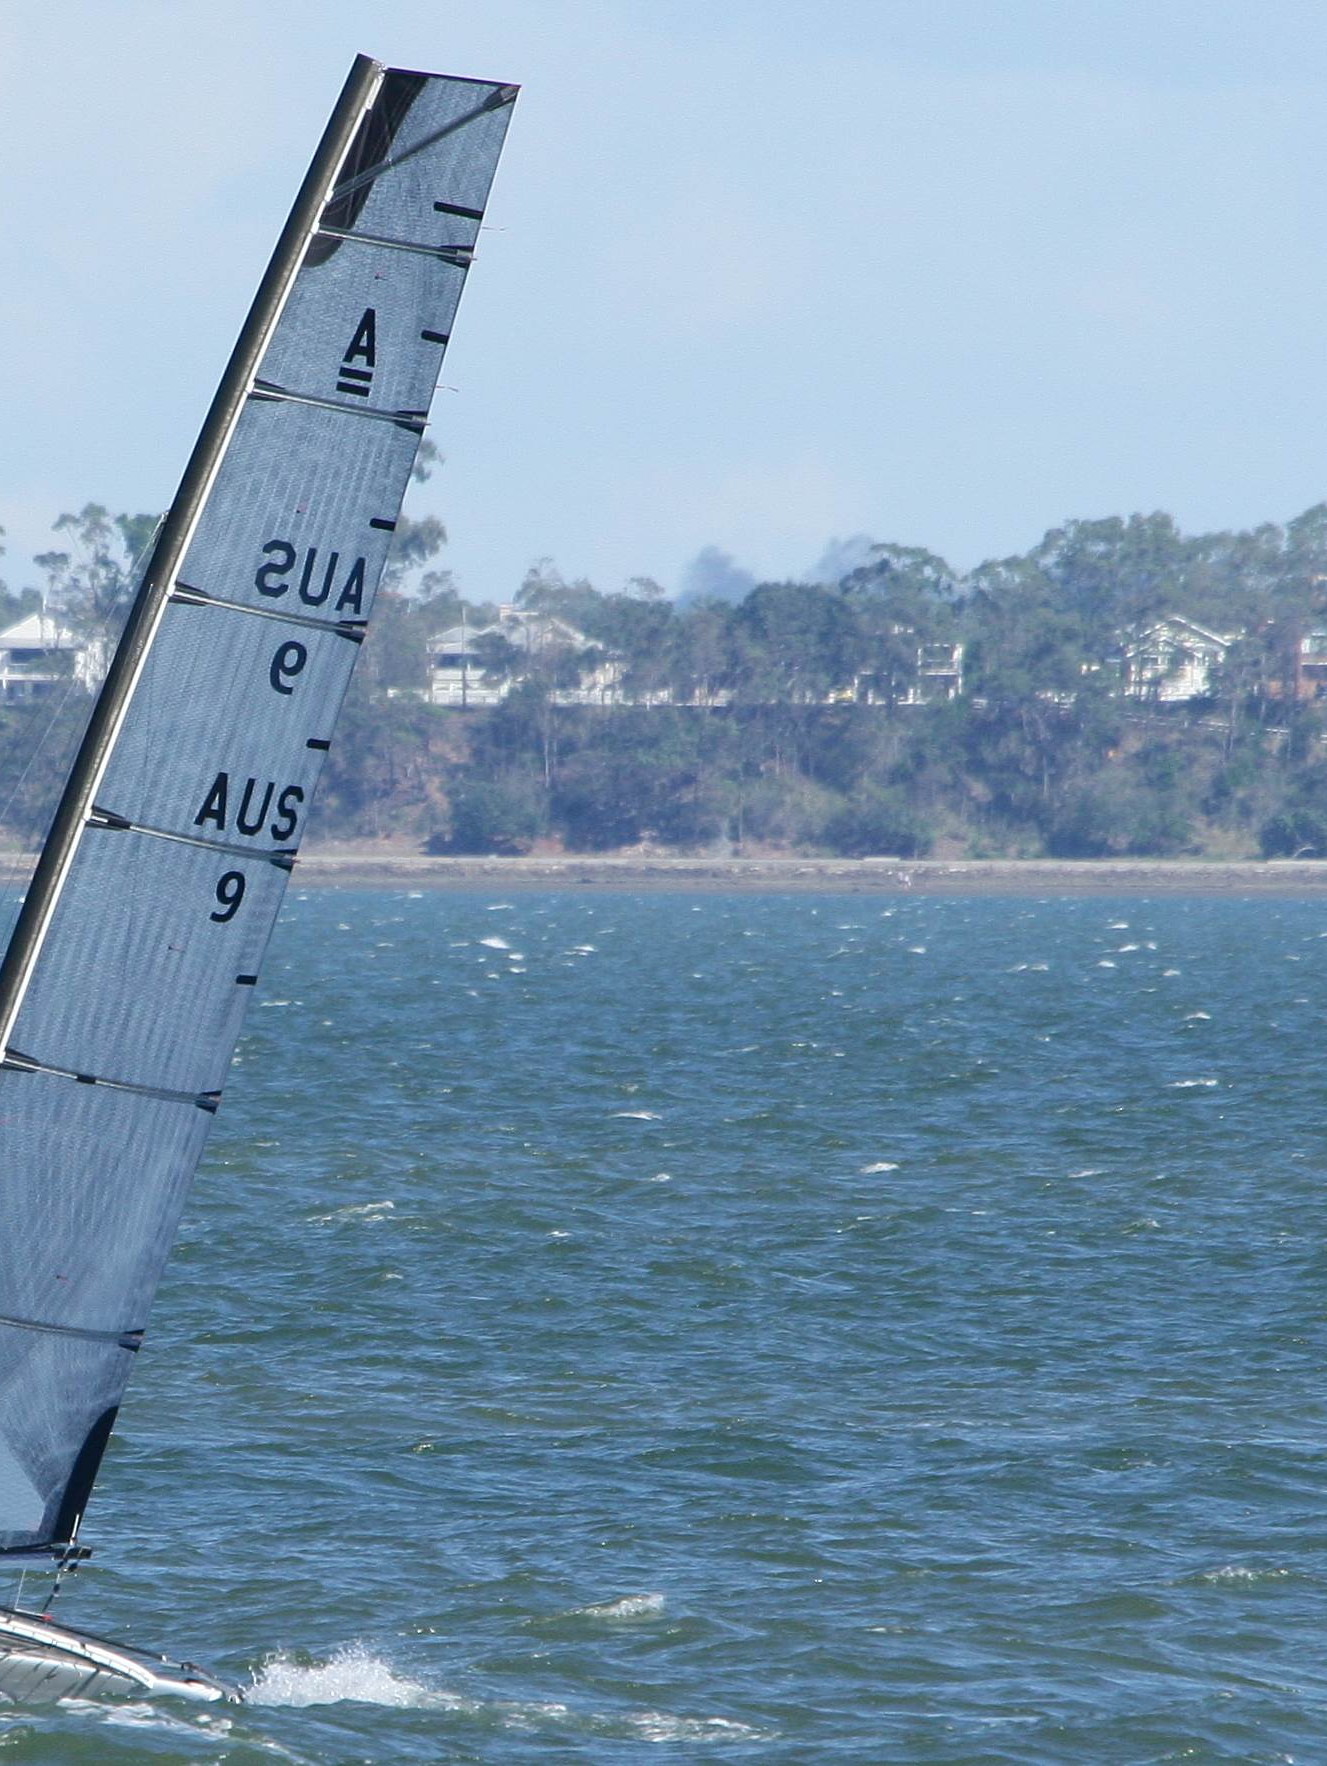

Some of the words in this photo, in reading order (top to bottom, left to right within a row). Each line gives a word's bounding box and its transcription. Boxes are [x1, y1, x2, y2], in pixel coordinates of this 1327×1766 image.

[342, 307, 376, 367] A
[193, 771, 305, 842] AUS
[209, 870, 246, 923] 9
